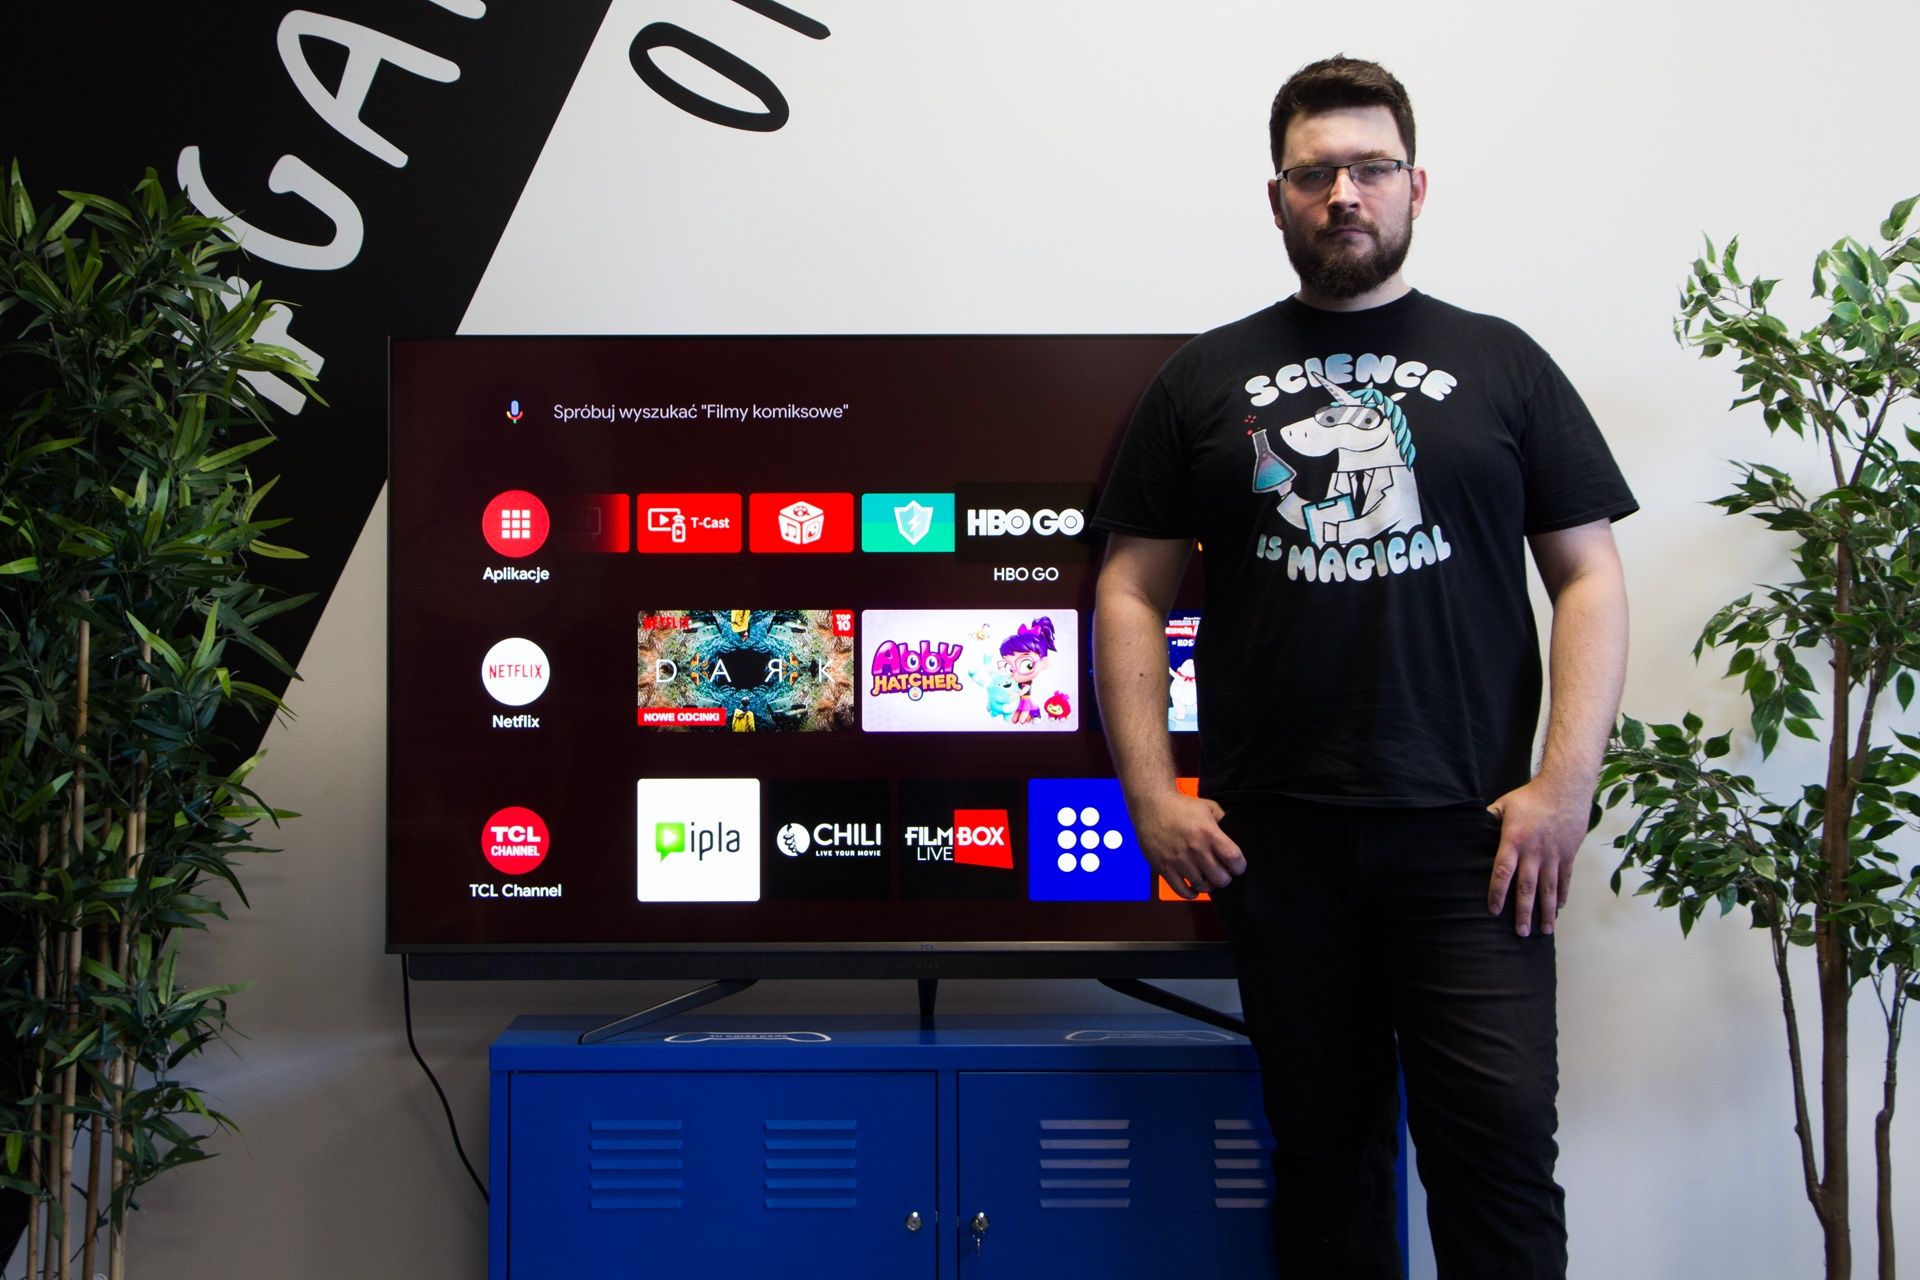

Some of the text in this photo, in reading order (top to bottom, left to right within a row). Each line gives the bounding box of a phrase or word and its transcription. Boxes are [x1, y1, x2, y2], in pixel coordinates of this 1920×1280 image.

[1245, 353, 1458, 407] SCIENCE
[553, 402, 849, 423] Spróbuj wyszukać "Filmy komiksowe"
[690, 516, 730, 530] T-Cast
[967, 508, 1084, 536] HBO GO
[1256, 525, 1451, 583] IS MAGICAL
[483, 566, 550, 583] Aplikacje
[994, 567, 1059, 581] HBO GO
[836, 620, 851, 630] 10
[489, 664, 543, 679] NETFLIX
[871, 671, 964, 696] HATCHER
[492, 714, 540, 729] Netflix
[644, 712, 720, 722] NOWE ODCINKI
[491, 826, 541, 843] TCL
[691, 822, 740, 861] ipla
[813, 823, 882, 846] CHILI
[491, 845, 540, 857] CHANNEL
[917, 847, 954, 861] LIVE
[470, 884, 562, 897] TCL Channel
